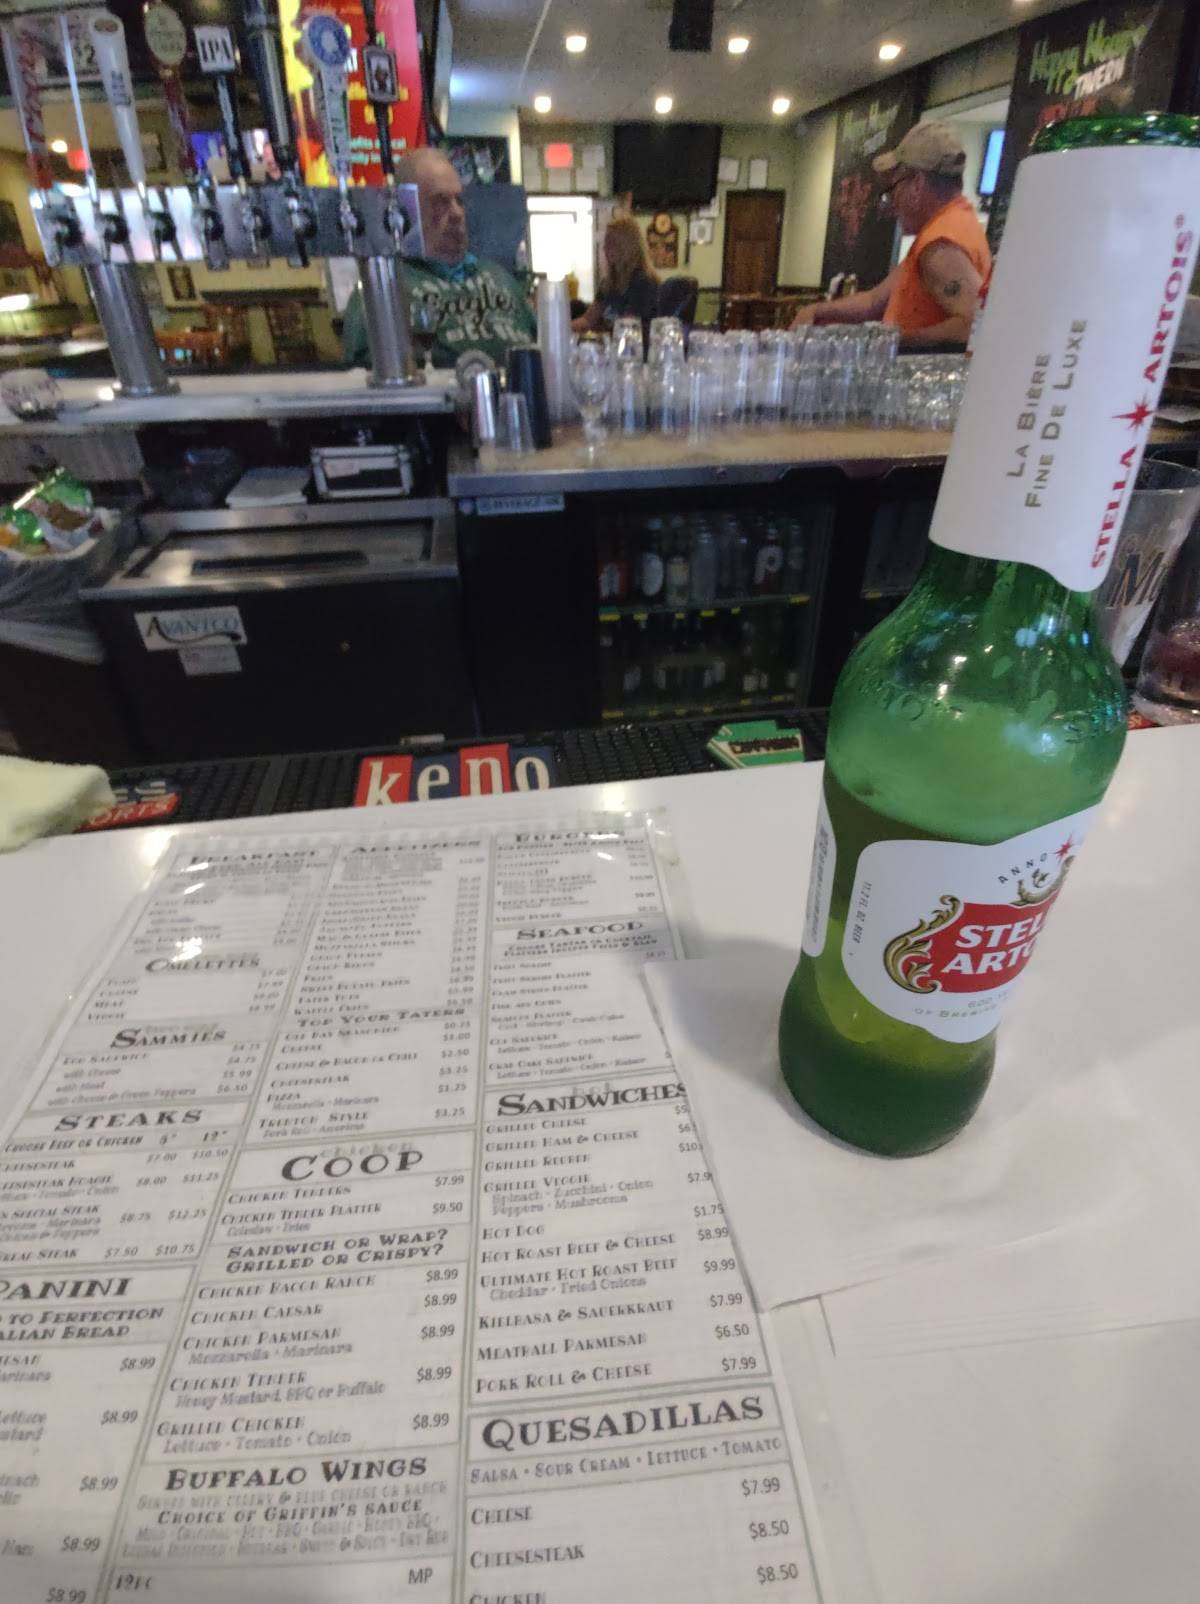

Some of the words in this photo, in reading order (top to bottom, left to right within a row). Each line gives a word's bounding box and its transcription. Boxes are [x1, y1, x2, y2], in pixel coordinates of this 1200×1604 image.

[1091, 446, 1136, 569] STELLA
[365, 756, 549, 807] keno
[997, 852, 1048, 885] ANNO
[517, 922, 642, 940] SEAFOOD
[955, 912, 1042, 948] STEL
[110, 1028, 227, 1049] SAMMIES
[497, 1083, 688, 1117] SANDWICHES
[54, 1110, 202, 1132] STEAKS
[281, 1150, 423, 1181] COOP
[435, 1175, 464, 1188] $7.99
[687, 1171, 713, 1184] $7.9
[432, 1202, 463, 1215] $9.50
[693, 1204, 724, 1218] $1.75
[698, 1227, 729, 1242] $8.99
[226, 1240, 336, 1259] SANDWICH
[344, 1239, 370, 1250] OR
[379, 1229, 448, 1246] WRAP?
[226, 1258, 314, 1274] GRILLED
[322, 1254, 349, 1266] OR
[357, 1244, 444, 1263] CRISPY?
[703, 1259, 736, 1273] $9.99
[426, 1269, 458, 1283] $8.99
[424, 1294, 457, 1308] $8.99
[710, 1293, 743, 1308] $7.99
[0, 1329, 55, 1341] ALIAN
[61, 1325, 130, 1339] BREAD
[420, 1324, 455, 1340] $8.99
[714, 1324, 750, 1340] $6.50
[120, 1357, 155, 1372] $8.99
[721, 1357, 757, 1372] $7.99
[416, 1367, 452, 1383] $8.99
[101, 1411, 138, 1425] $8.99
[412, 1413, 450, 1430] $8.99
[482, 1396, 764, 1452] QUESADILLAS
[470, 1467, 518, 1484] SALSA
[535, 1462, 574, 1478] SOUR
[579, 1456, 631, 1474] CREAM
[647, 1447, 707, 1466] LETTUCE
[722, 1437, 782, 1456] TOMATO
[165, 1467, 307, 1491] BUFFALO
[321, 1457, 428, 1482] WINGS
[79, 1476, 118, 1491] $8.99
[741, 1477, 780, 1497] $7.99
[158, 1509, 226, 1525] CHOICE
[234, 1509, 257, 1522] OF
[365, 1499, 423, 1514] SAUCE
[749, 1519, 789, 1540] $8.50
[62, 1536, 100, 1552] $8.99
[408, 1567, 433, 1585] MP
[756, 1563, 798, 1584] $8.50
[46, 1587, 86, 1603] $8.99
